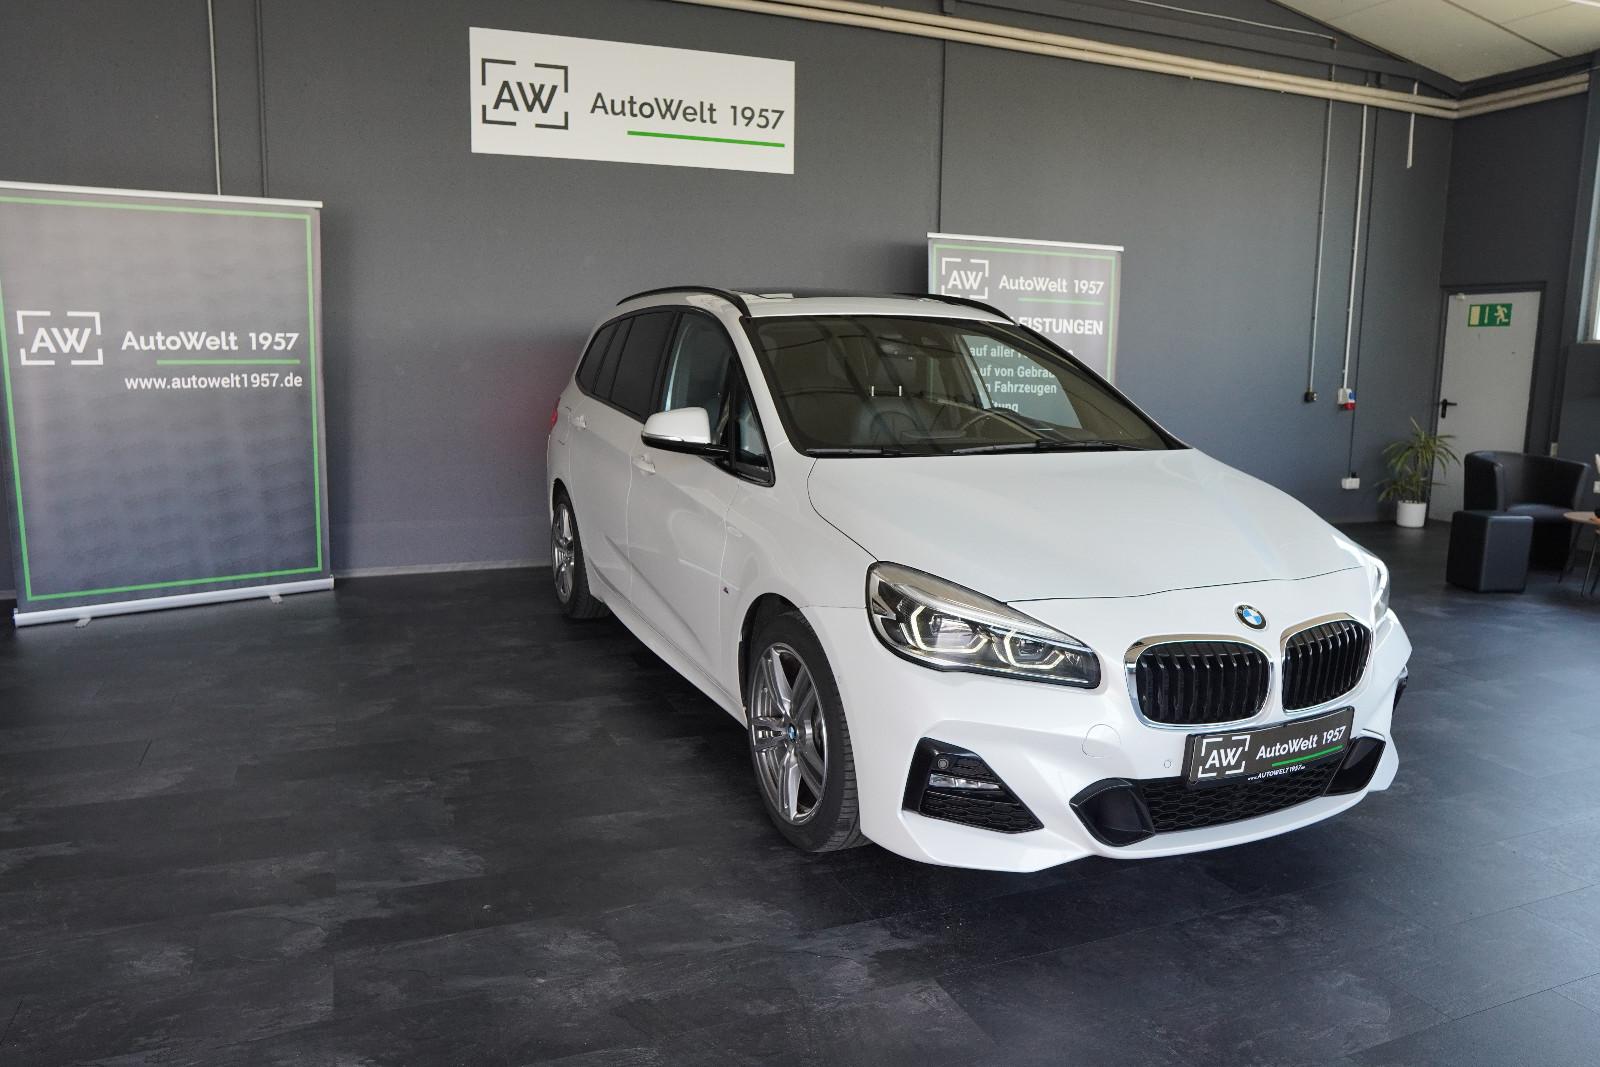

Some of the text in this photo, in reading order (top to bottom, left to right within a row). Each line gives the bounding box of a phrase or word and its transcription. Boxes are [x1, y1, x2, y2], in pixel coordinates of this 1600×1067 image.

[492, 80, 558, 114] AW
[590, 92, 785, 130] AutoWelt 1957
[947, 270, 983, 290] AW
[998, 275, 1104, 295] AutoWelt 1957
[1010, 316, 1104, 335] EISTUNGEN
[30, 327, 91, 353] AW
[121, 330, 299, 351] AutoWelt 1957
[124, 372, 303, 390] www.autowelt1957.de
[994, 367, 1014, 377] von
[994, 381, 1057, 397] Fahrzeugen
[992, 400, 1019, 413] tung
[1255, 725, 1346, 760] AutoWelt 1957
[1205, 748, 1243, 769] AW
